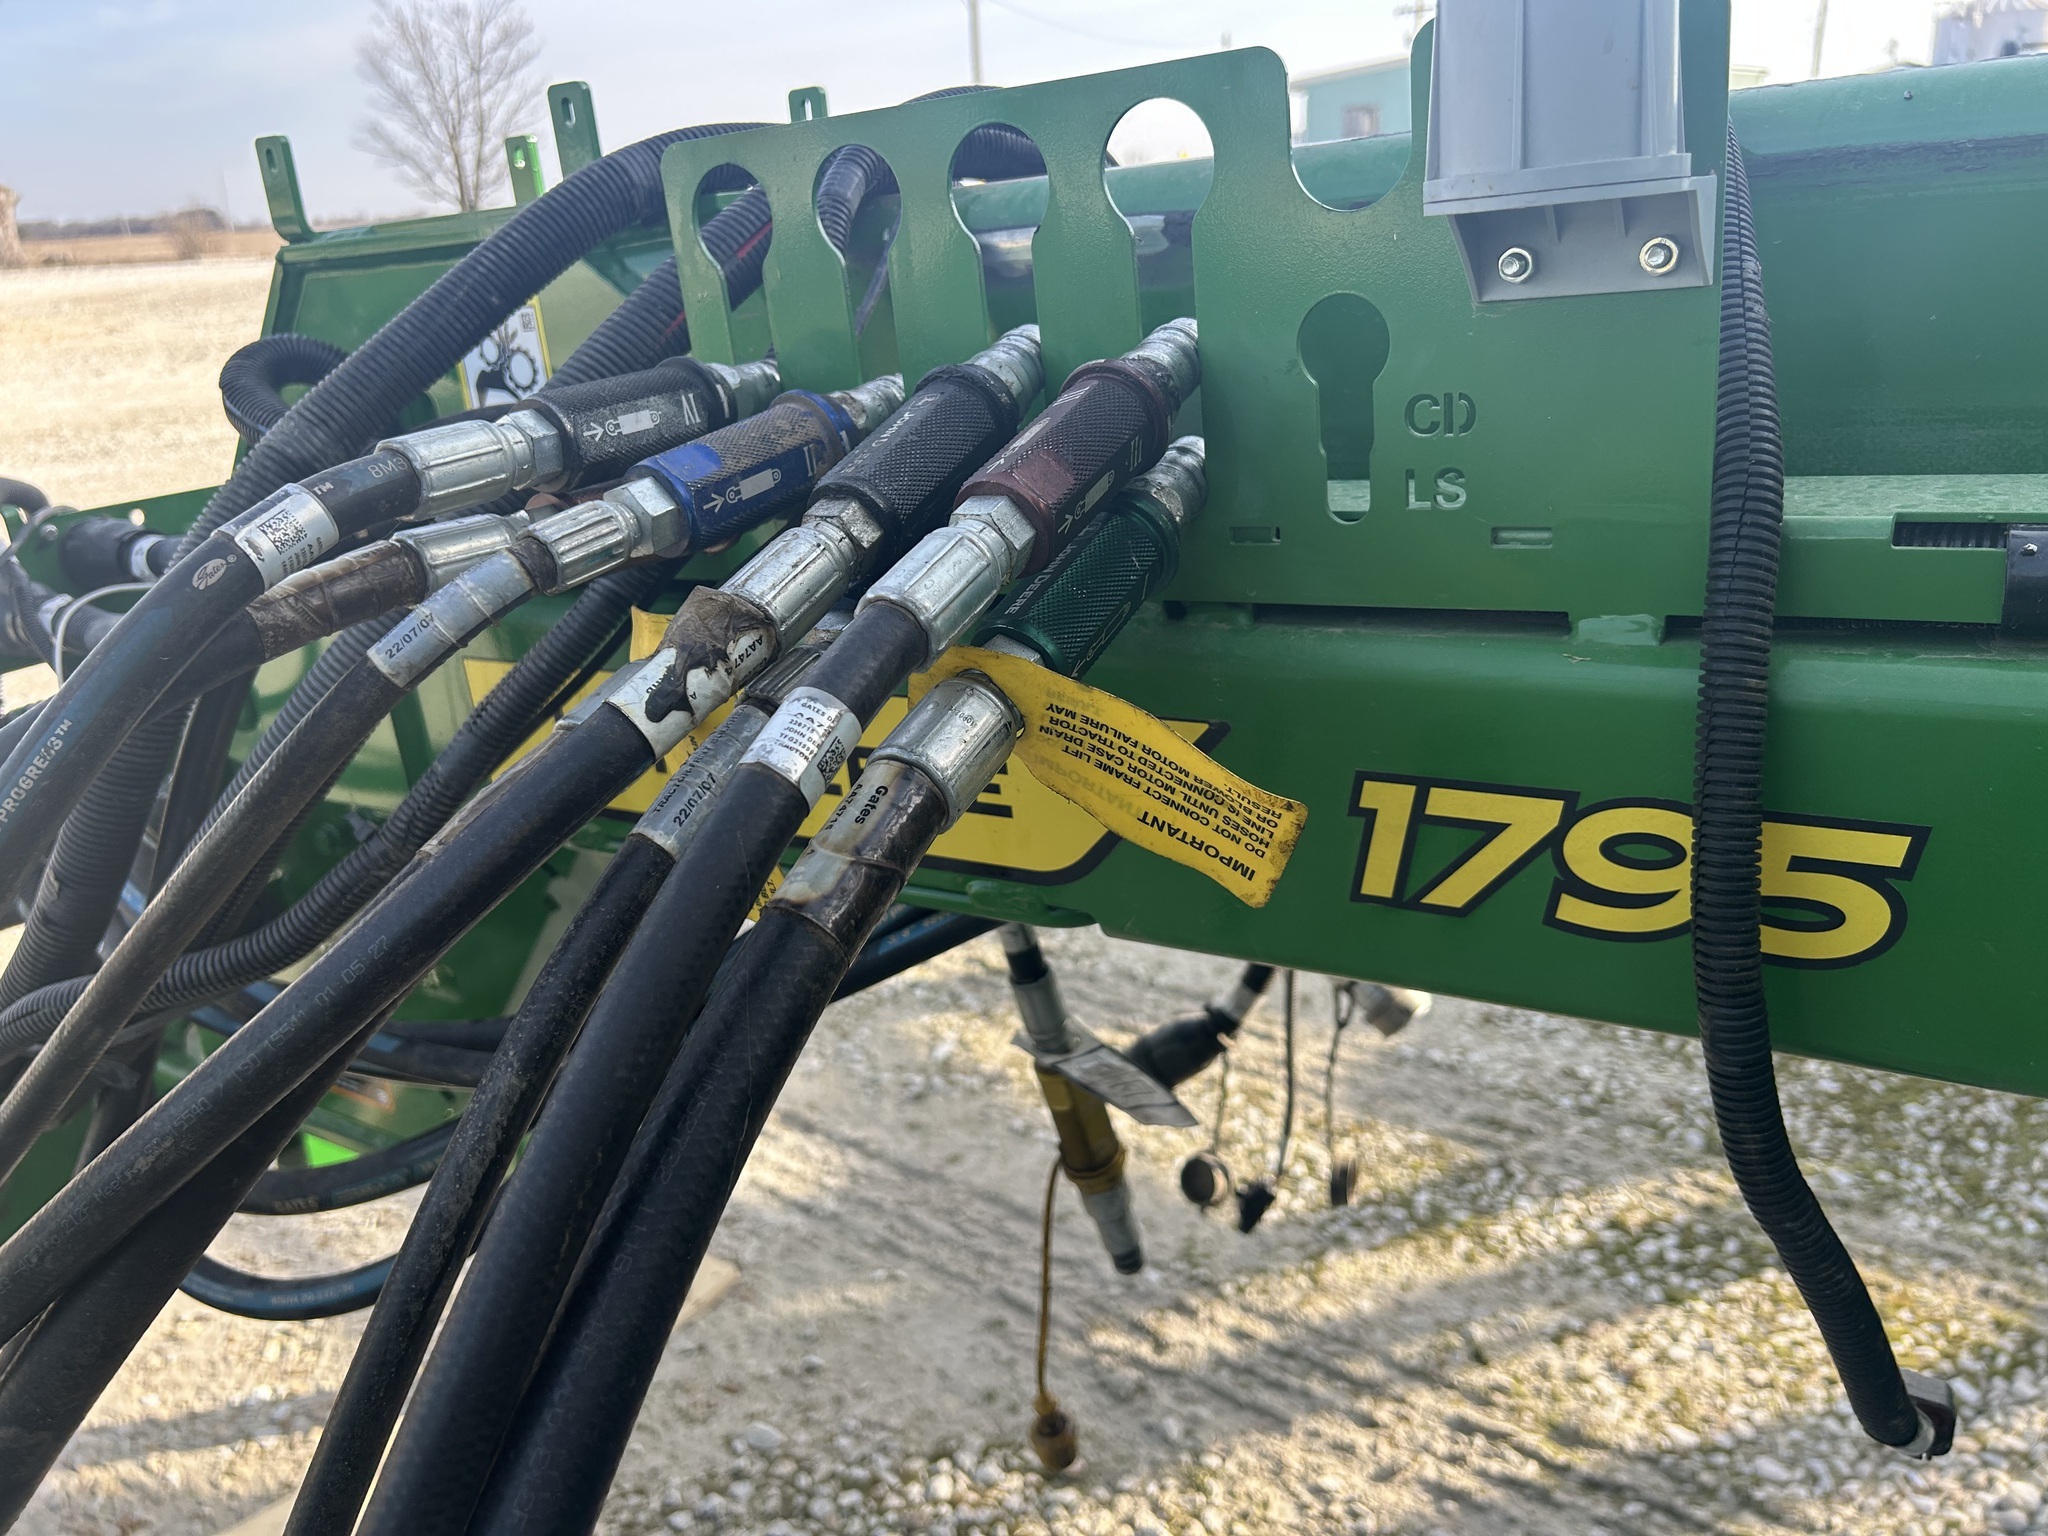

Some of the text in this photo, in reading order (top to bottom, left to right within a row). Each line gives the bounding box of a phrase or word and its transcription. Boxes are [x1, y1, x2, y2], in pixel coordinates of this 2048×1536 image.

[1404, 392, 1477, 437] CD
[1406, 467, 1468, 511] LS
[1003, 541, 1077, 618] JOHN DEERE
[383, 611, 437, 659] 22/07/07
[800, 701, 826, 717] GATES
[1045, 701, 1076, 720] MAY
[783, 724, 807, 738] JOHN
[1037, 723, 1084, 747] DRAIN
[1047, 714, 1117, 750] TRACTOR
[1078, 713, 1139, 749] FAILURE
[1084, 741, 1125, 767] CASE
[1114, 743, 1137, 760] TO
[1139, 743, 1191, 777] MOTOR
[1125, 762, 1177, 795] MOTOR
[1137, 754, 1226, 806] CONNECTED
[1191, 774, 1253, 815] BLOWER
[672, 771, 718, 827] 22/07/07
[853, 783, 889, 826] Gates
[1061, 743, 1266, 858] DO NOT CONNECT FRAME LIFT
[1177, 790, 1219, 818] UNTIL
[1221, 783, 1282, 819] RESULT.
[1227, 804, 1240, 816] IS
[1220, 814, 1270, 848] HOSES
[1241, 814, 1274, 838] LINE
[1253, 810, 1279, 829] OR
[1135, 808, 1256, 881] IMPORTANT
[1347, 769, 1932, 970] 1795
